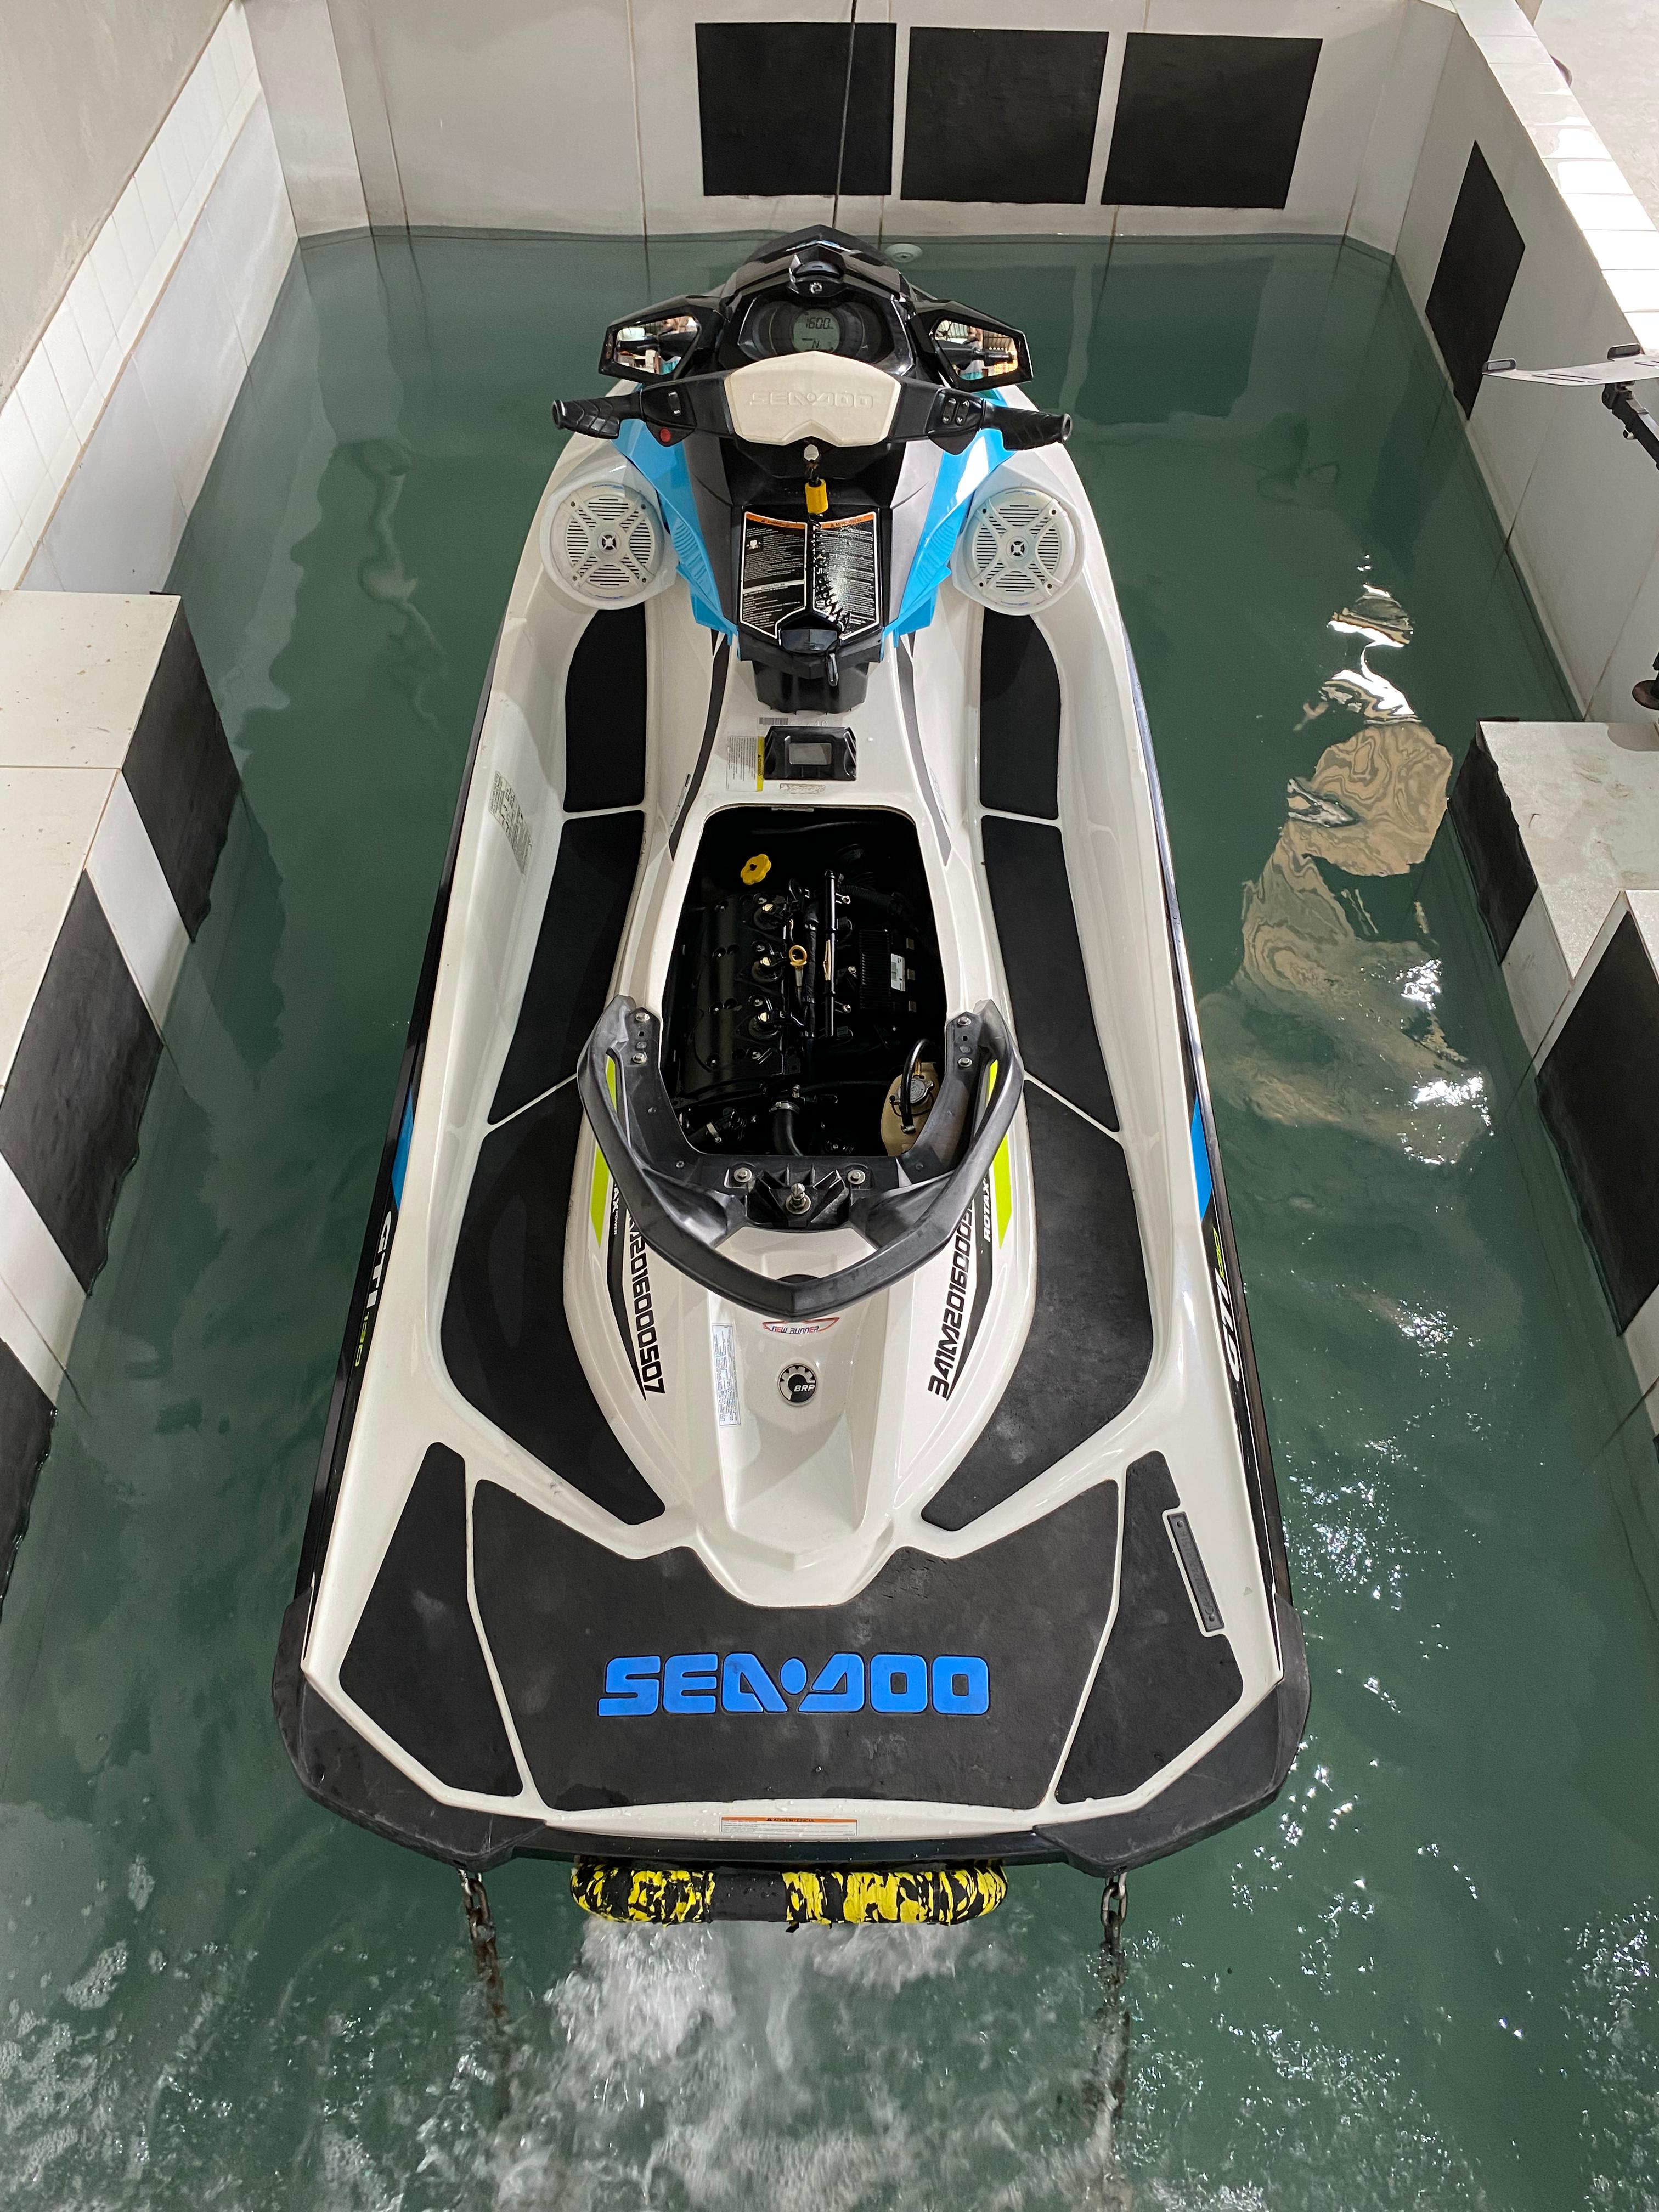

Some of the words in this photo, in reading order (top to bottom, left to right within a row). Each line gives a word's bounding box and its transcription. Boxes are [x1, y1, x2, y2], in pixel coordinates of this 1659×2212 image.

[805, 317, 831, 329] 1600
[983, 1180, 991, 1243] ROTAX
[366, 1210, 392, 1308] GTI
[1214, 1268, 1240, 1383] GTI
